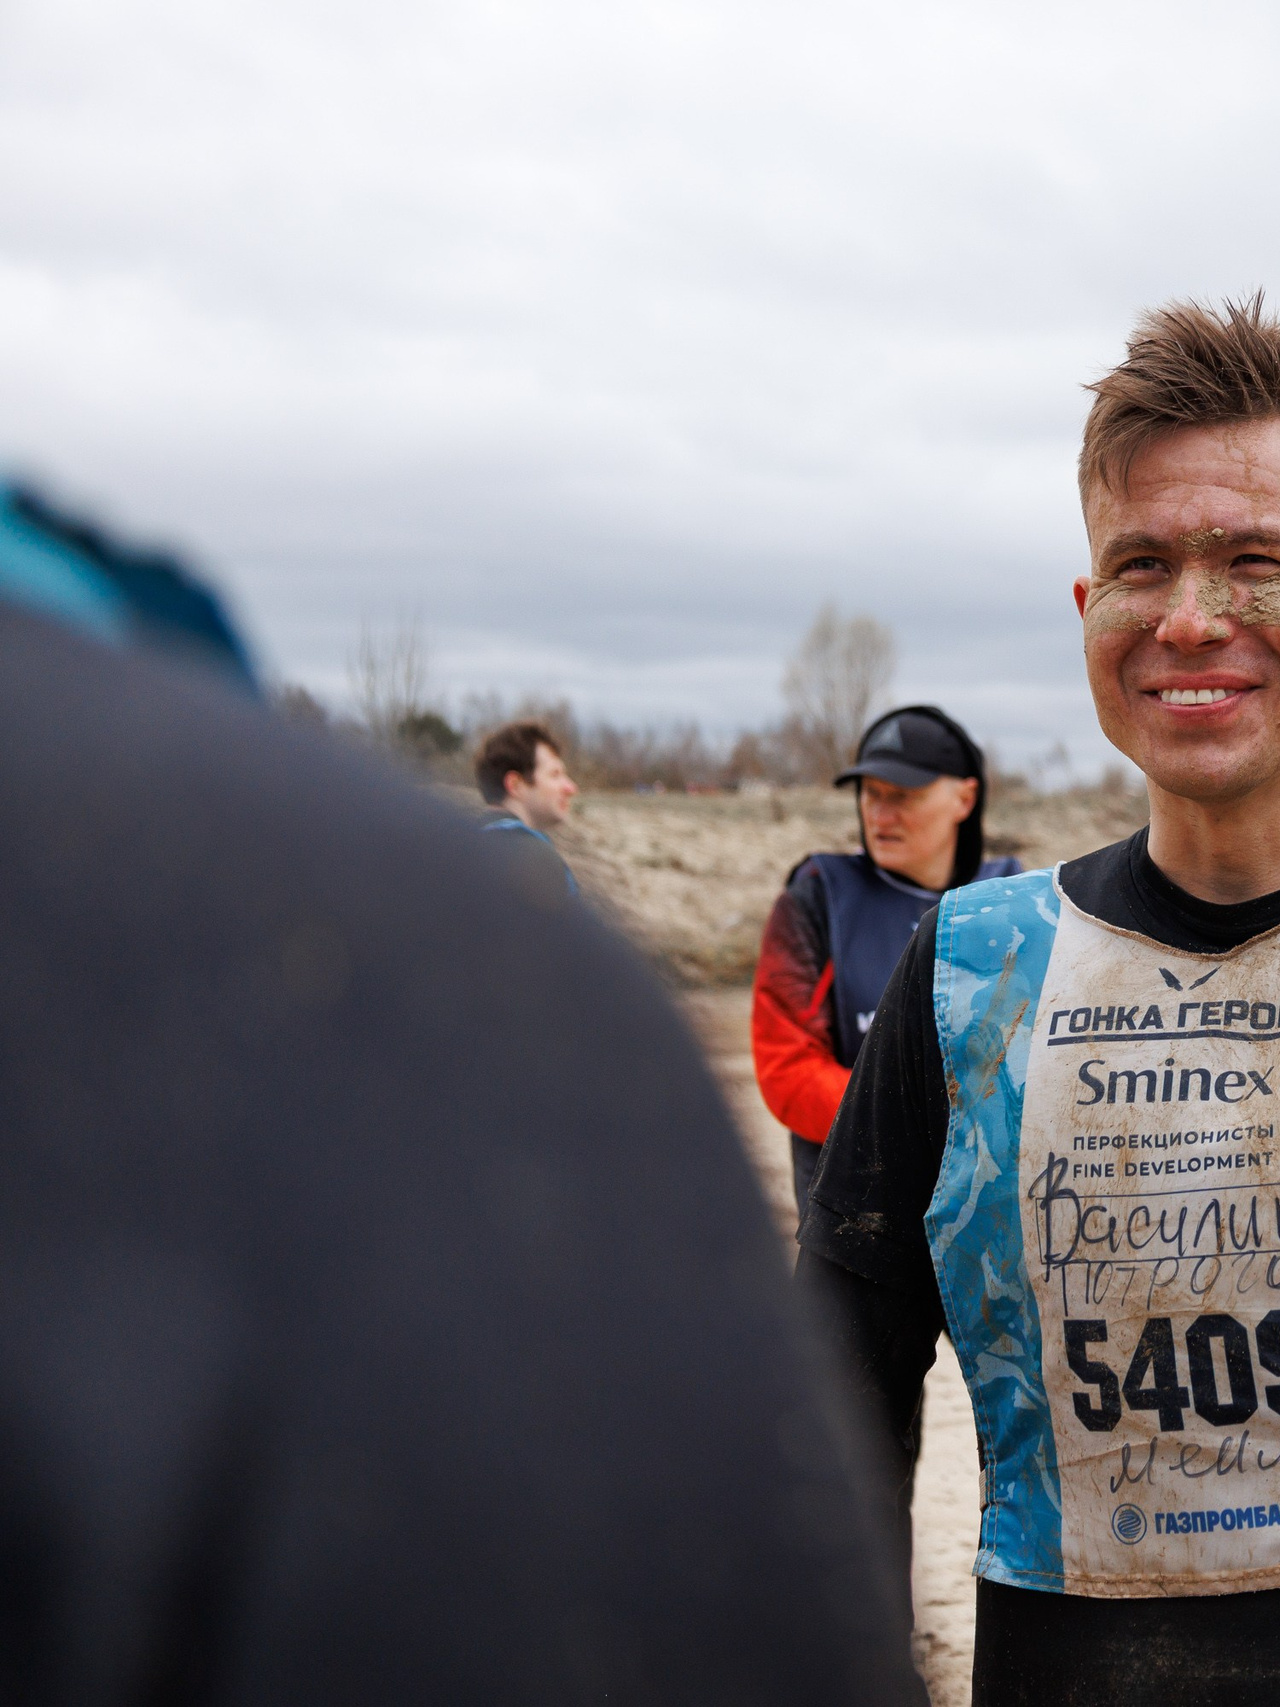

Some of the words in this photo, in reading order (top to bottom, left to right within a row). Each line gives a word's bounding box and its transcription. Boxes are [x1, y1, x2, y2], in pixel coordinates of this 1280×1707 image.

[1049, 1004, 1165, 1036] ГОНКА
[1076, 1058, 1275, 1106] Sminex
[1073, 1124, 1274, 1151] ПЕРФЕКЦИОНИСТЫ
[1073, 1161, 1115, 1178] FINE
[1125, 1151, 1273, 1177] DEVELOPMENT
